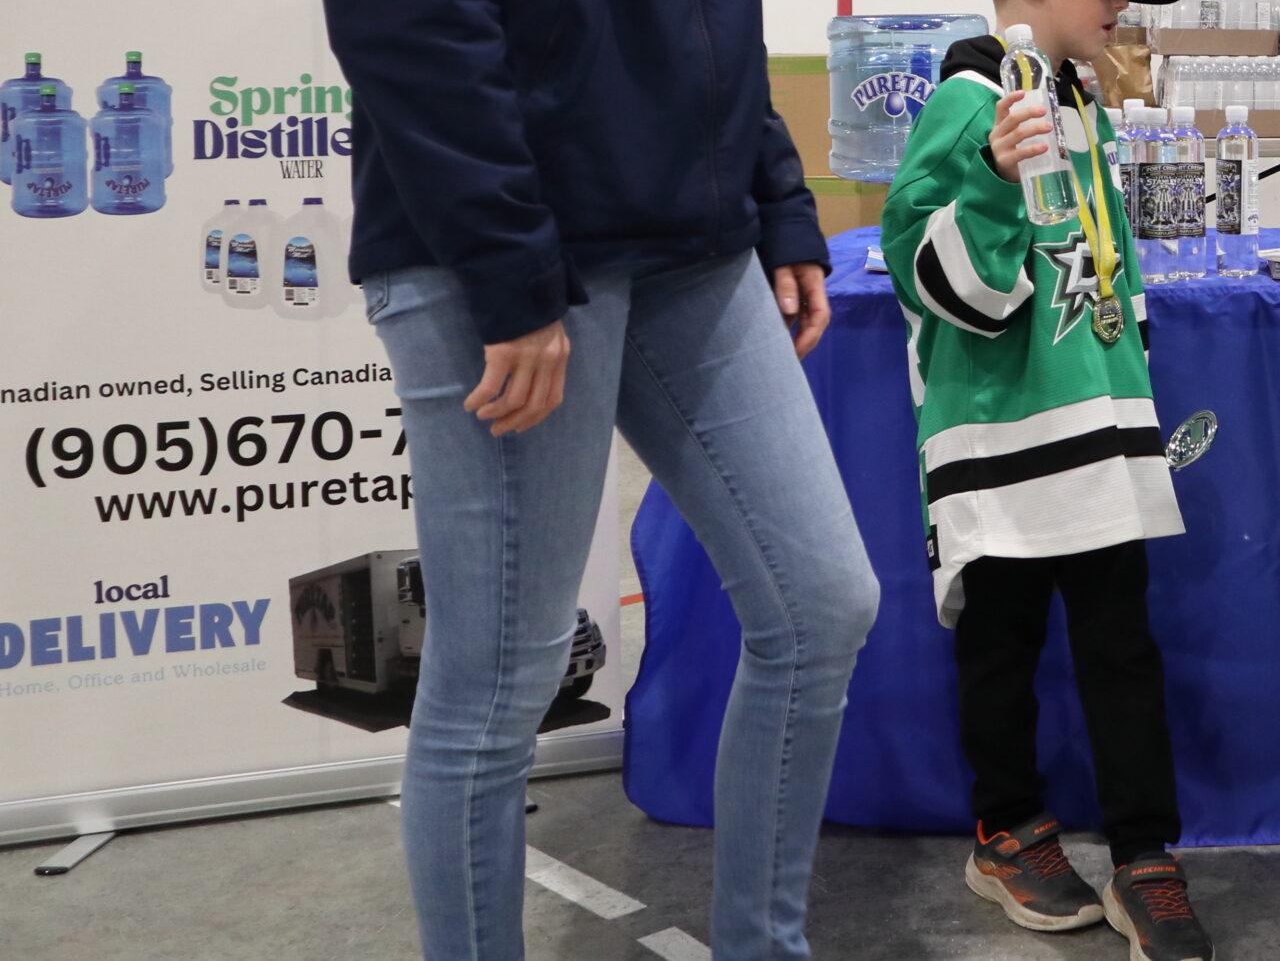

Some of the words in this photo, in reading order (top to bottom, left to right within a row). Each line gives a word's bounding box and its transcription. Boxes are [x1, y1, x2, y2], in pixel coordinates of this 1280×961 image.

[193, 115, 352, 160] Distille
[280, 159, 323, 179] WATER
[98, 374, 193, 398] owned,
[199, 369, 285, 392] Selling
[292, 363, 392, 386] Canadia
[93, 575, 170, 604] local
[0, 598, 271, 670] DELIVERY
[68, 672, 124, 690] Office
[131, 666, 165, 684] and
[173, 657, 267, 680] Wholesale
